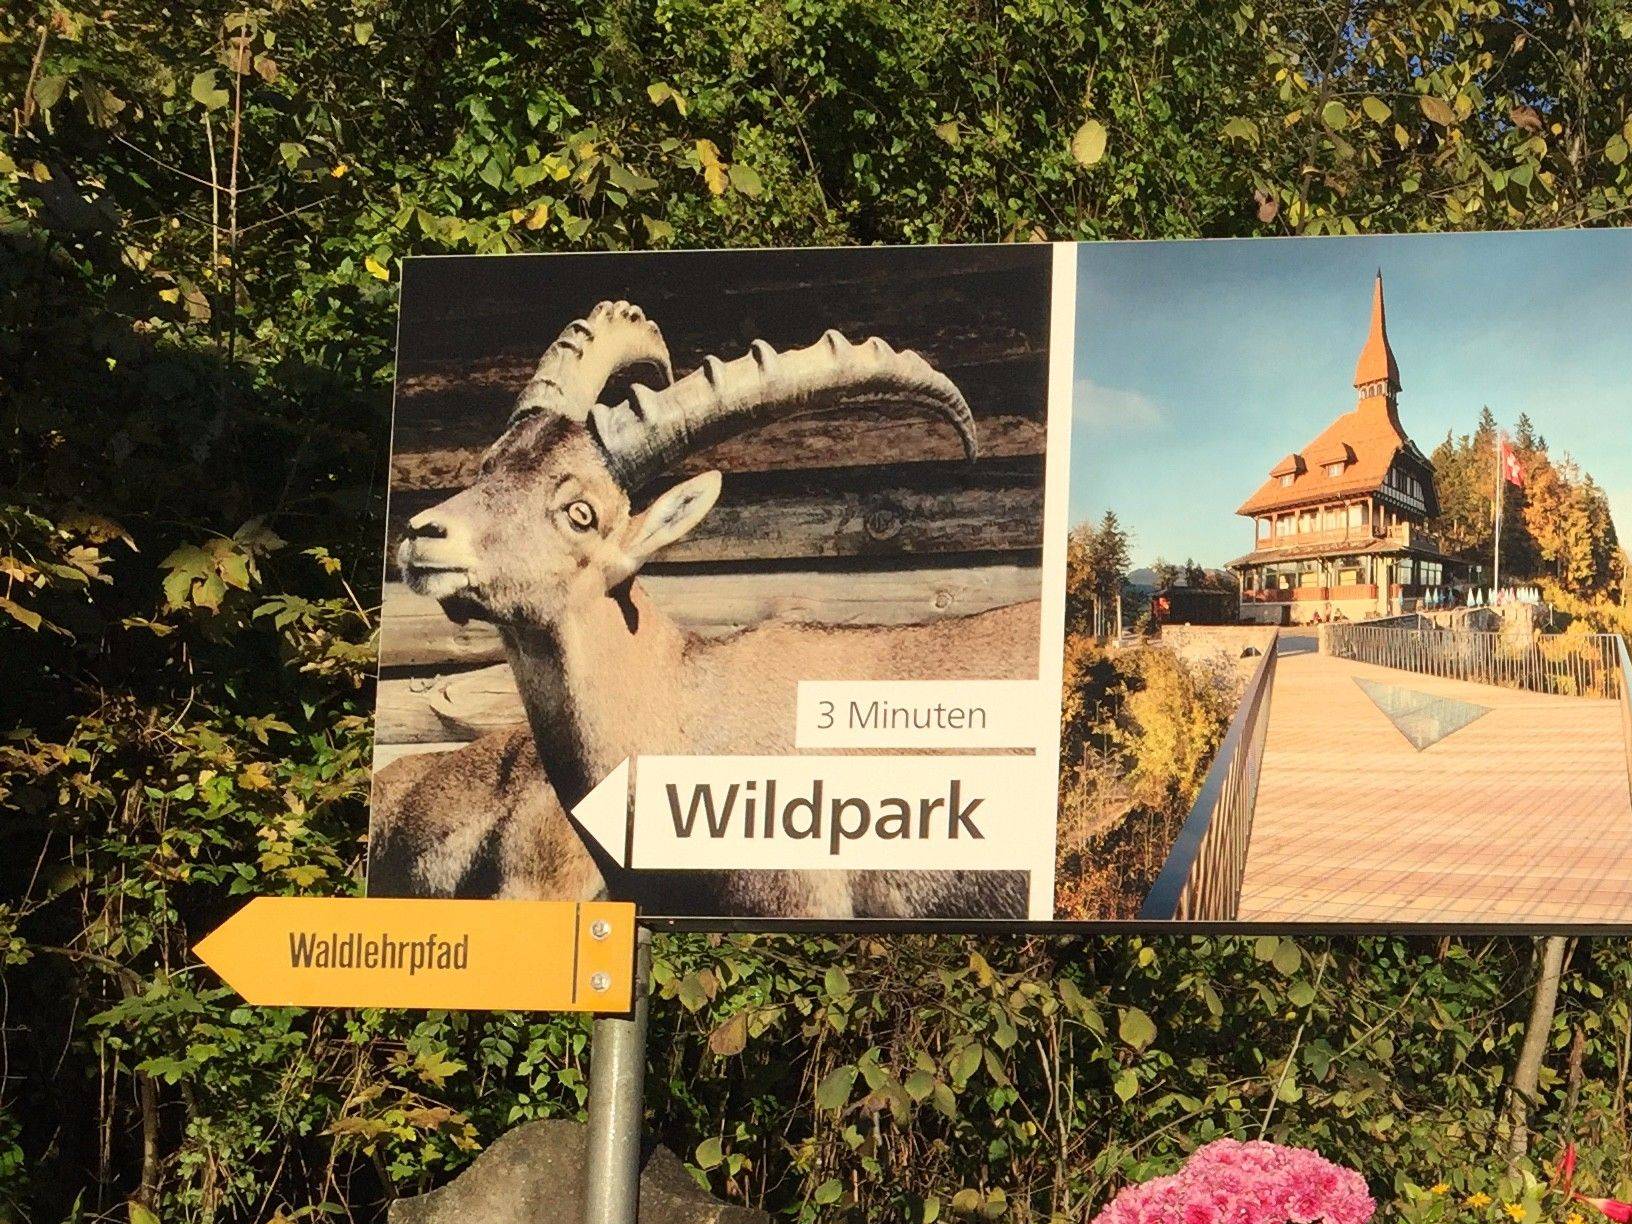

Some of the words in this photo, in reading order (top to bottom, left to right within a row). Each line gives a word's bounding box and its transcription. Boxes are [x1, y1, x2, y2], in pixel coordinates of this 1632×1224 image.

[816, 700, 834, 730] 3
[848, 700, 987, 730] Minuten
[664, 778, 986, 855] Wildpark
[289, 931, 469, 975] Waldlehrpfad
